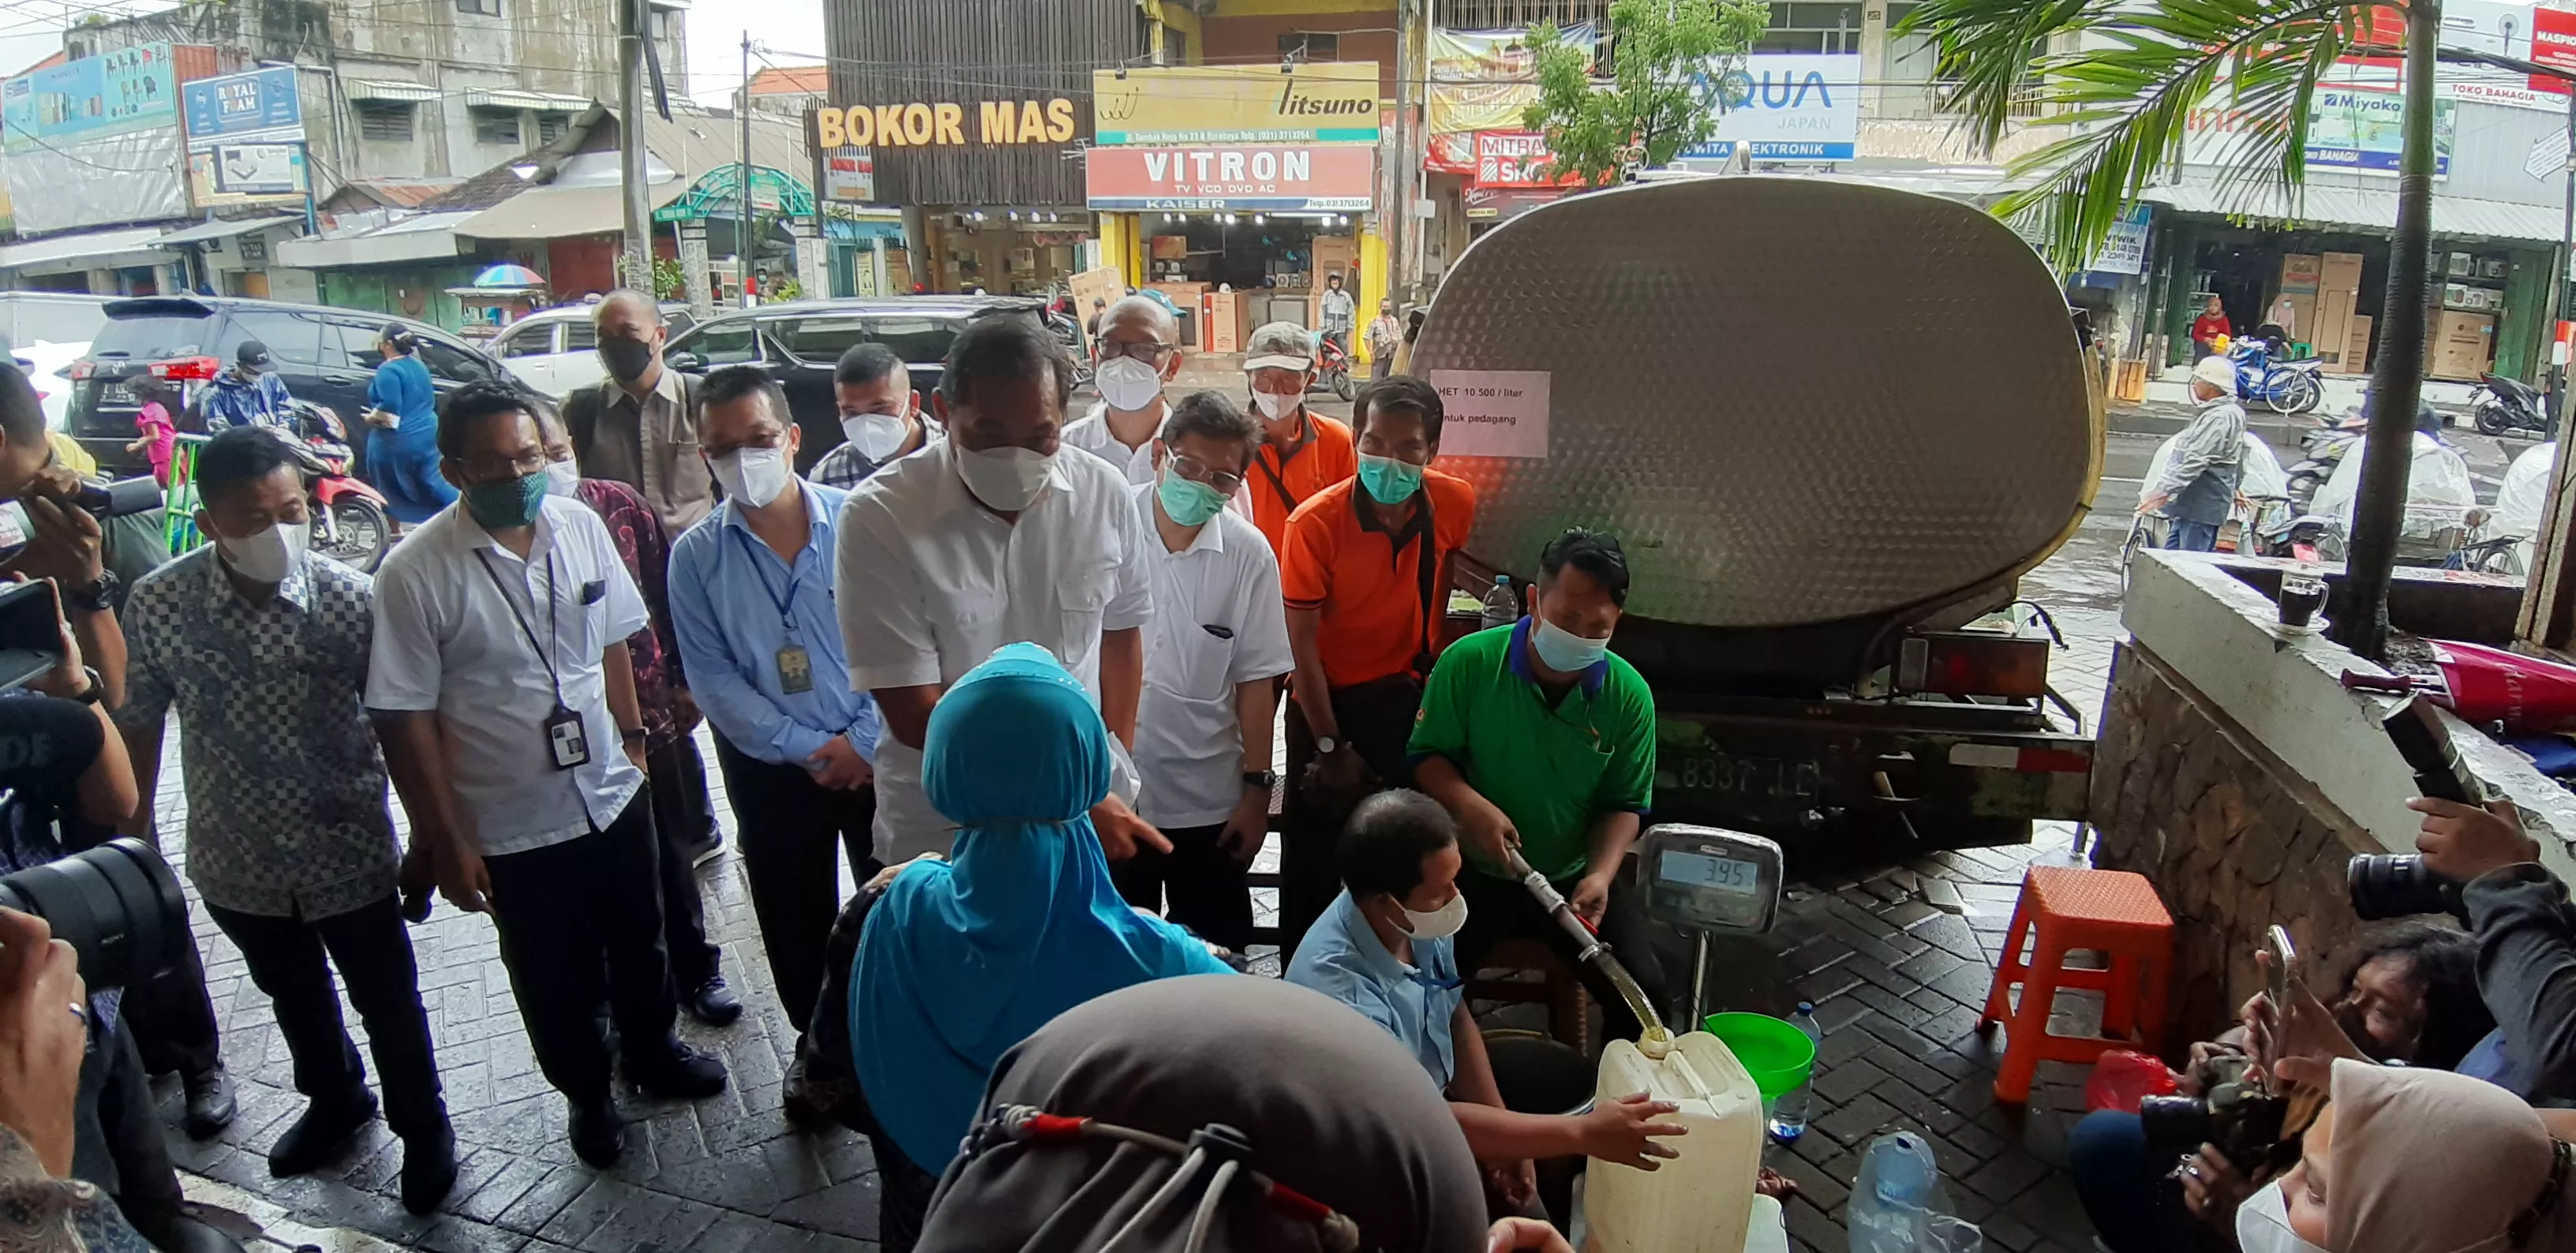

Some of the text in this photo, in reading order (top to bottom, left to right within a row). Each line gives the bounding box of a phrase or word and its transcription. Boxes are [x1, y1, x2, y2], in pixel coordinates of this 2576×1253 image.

[218, 82, 256, 100] ROYAL
[2451, 84, 2481, 95] TOKO
[2486, 88, 2537, 102] BAHAGIA
[223, 96, 256, 114] FOAM
[2339, 95, 2401, 113] Miyako
[818, 98, 1075, 148] BOKOR MAS
[1777, 118, 1831, 129] JAPAN
[1482, 138, 1543, 155] MITRA
[1144, 151, 1310, 181] VITRON
[1174, 185, 1191, 193] TV
[1146, 199, 1226, 209] KAISER
[1439, 387, 1458, 396] HET
[1478, 388, 1495, 397] 500
[1503, 388, 1523, 398] liter
[1443, 413, 1516, 426] ntuk pedagang
[1682, 757, 1757, 792] 8337
